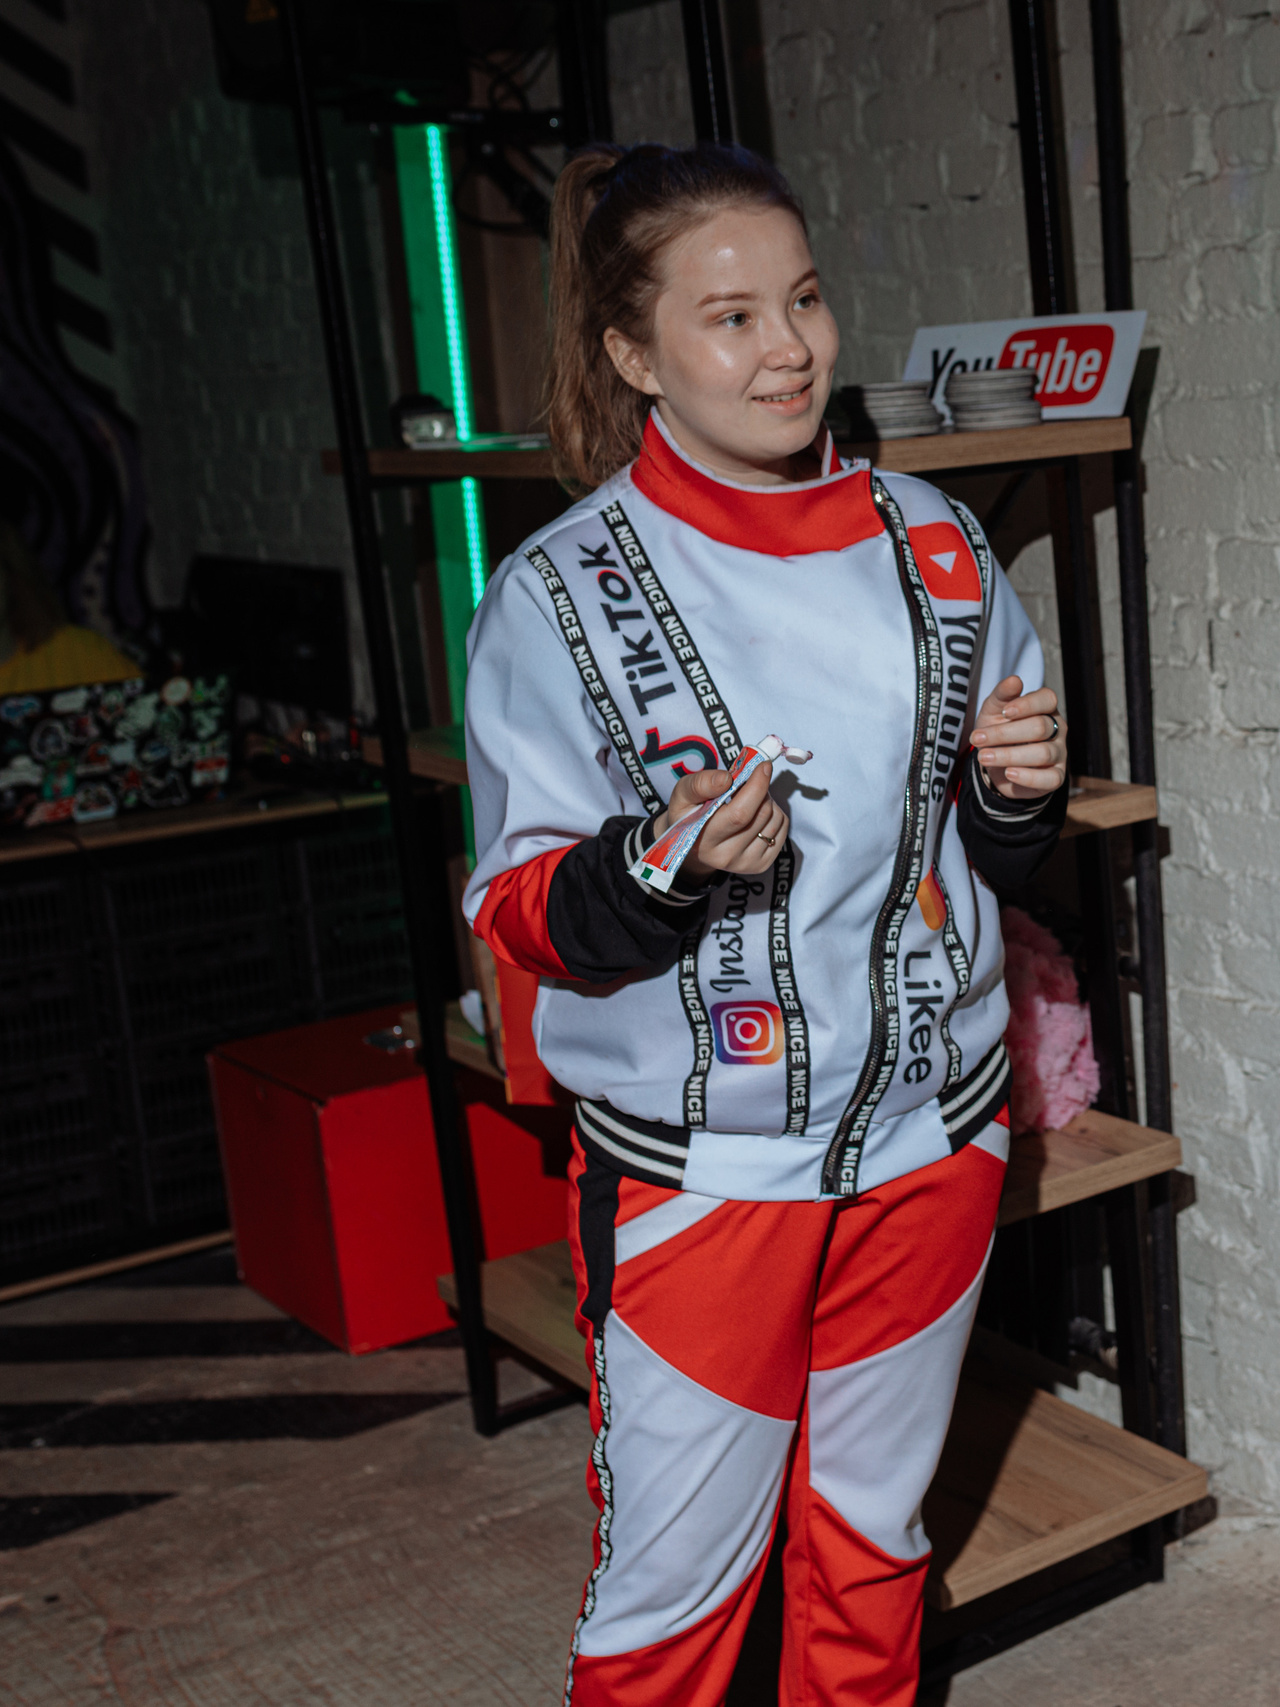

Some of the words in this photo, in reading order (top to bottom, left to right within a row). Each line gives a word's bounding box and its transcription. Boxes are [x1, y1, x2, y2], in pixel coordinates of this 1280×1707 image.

[914, 589, 937, 631] NICE
[614, 524, 647, 568] NICE
[638, 570, 671, 614] NICE
[662, 614, 696, 661] NICE
[686, 660, 719, 709] NICE
[709, 709, 741, 761] NICE
[927, 636, 942, 684] NICE
[530, 553, 563, 591] NICE
[553, 592, 583, 642] NICE
[572, 645, 604, 696] NICE
[598, 698, 630, 748] NICE
[621, 750, 653, 798] NICE
[926, 691, 941, 741] NICE
[919, 746, 934, 797] NICE
[914, 802, 927, 851] NICE
[900, 857, 921, 906] NICE
[772, 912, 789, 963] NICE
[885, 908, 907, 954] NICE
[681, 977, 706, 1022] NICE
[775, 968, 799, 1011] NICE
[883, 959, 897, 1008] NICE
[788, 1016, 806, 1064] NICE
[883, 1013, 900, 1062] NICE
[903, 950, 944, 1085] Likee
[696, 1024, 710, 1073] NICE
[687, 1075, 703, 1123] NICE
[791, 1068, 807, 1109] NICE
[867, 1064, 893, 1104] NICE
[848, 1104, 875, 1143] NICE
[839, 1146, 859, 1195] NICE
